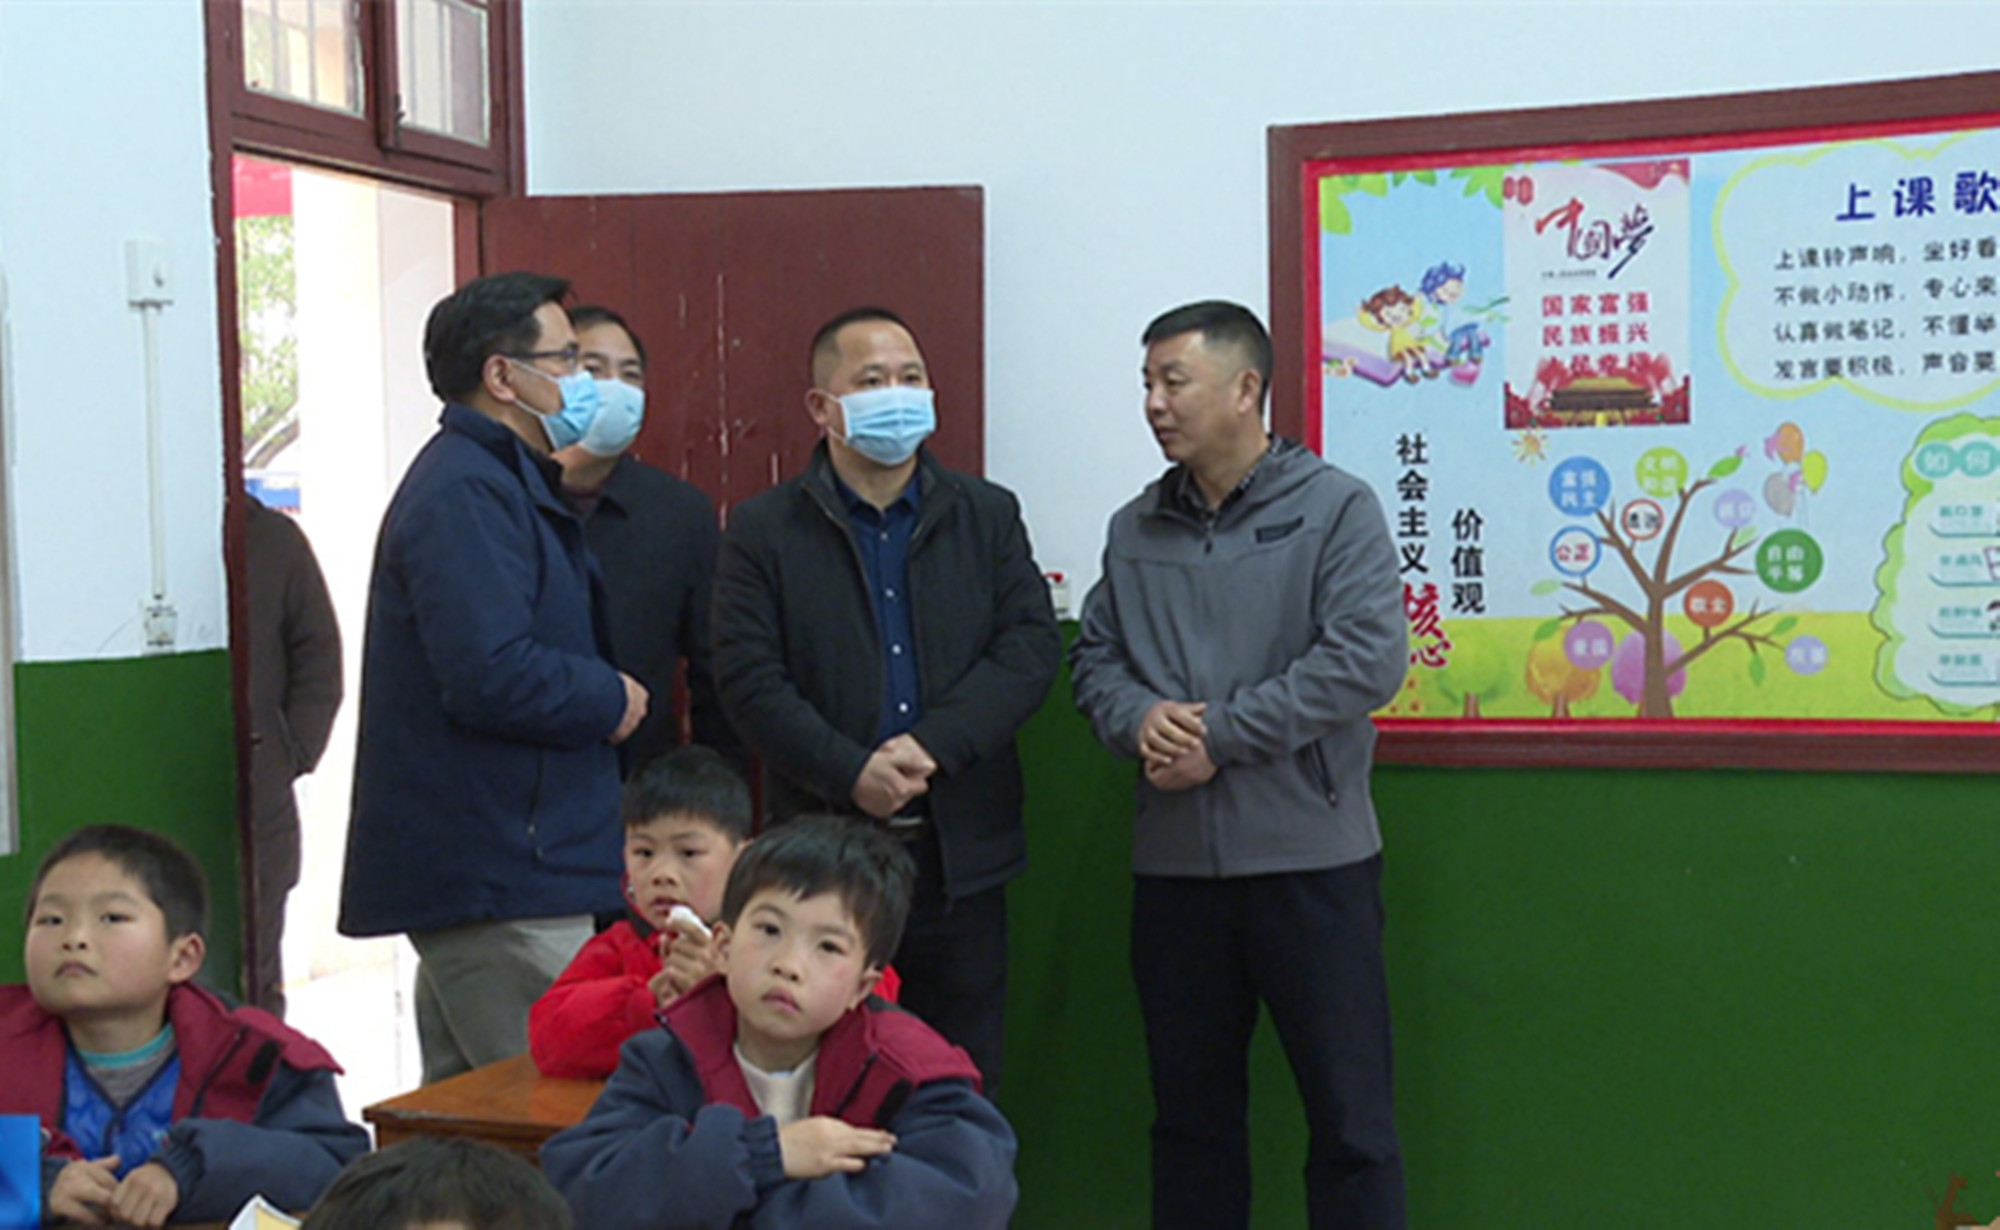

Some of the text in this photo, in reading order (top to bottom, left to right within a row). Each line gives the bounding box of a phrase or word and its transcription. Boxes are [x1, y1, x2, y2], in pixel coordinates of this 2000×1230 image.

[1835, 170, 2000, 222] 上课歌
[1535, 197, 1654, 279] 中国梦
[1542, 292, 1649, 318] 国家富强
[1543, 322, 1649, 347] 民族振兴
[1451, 508, 1485, 615] 价值观
[1556, 543, 1590, 562] 公正
